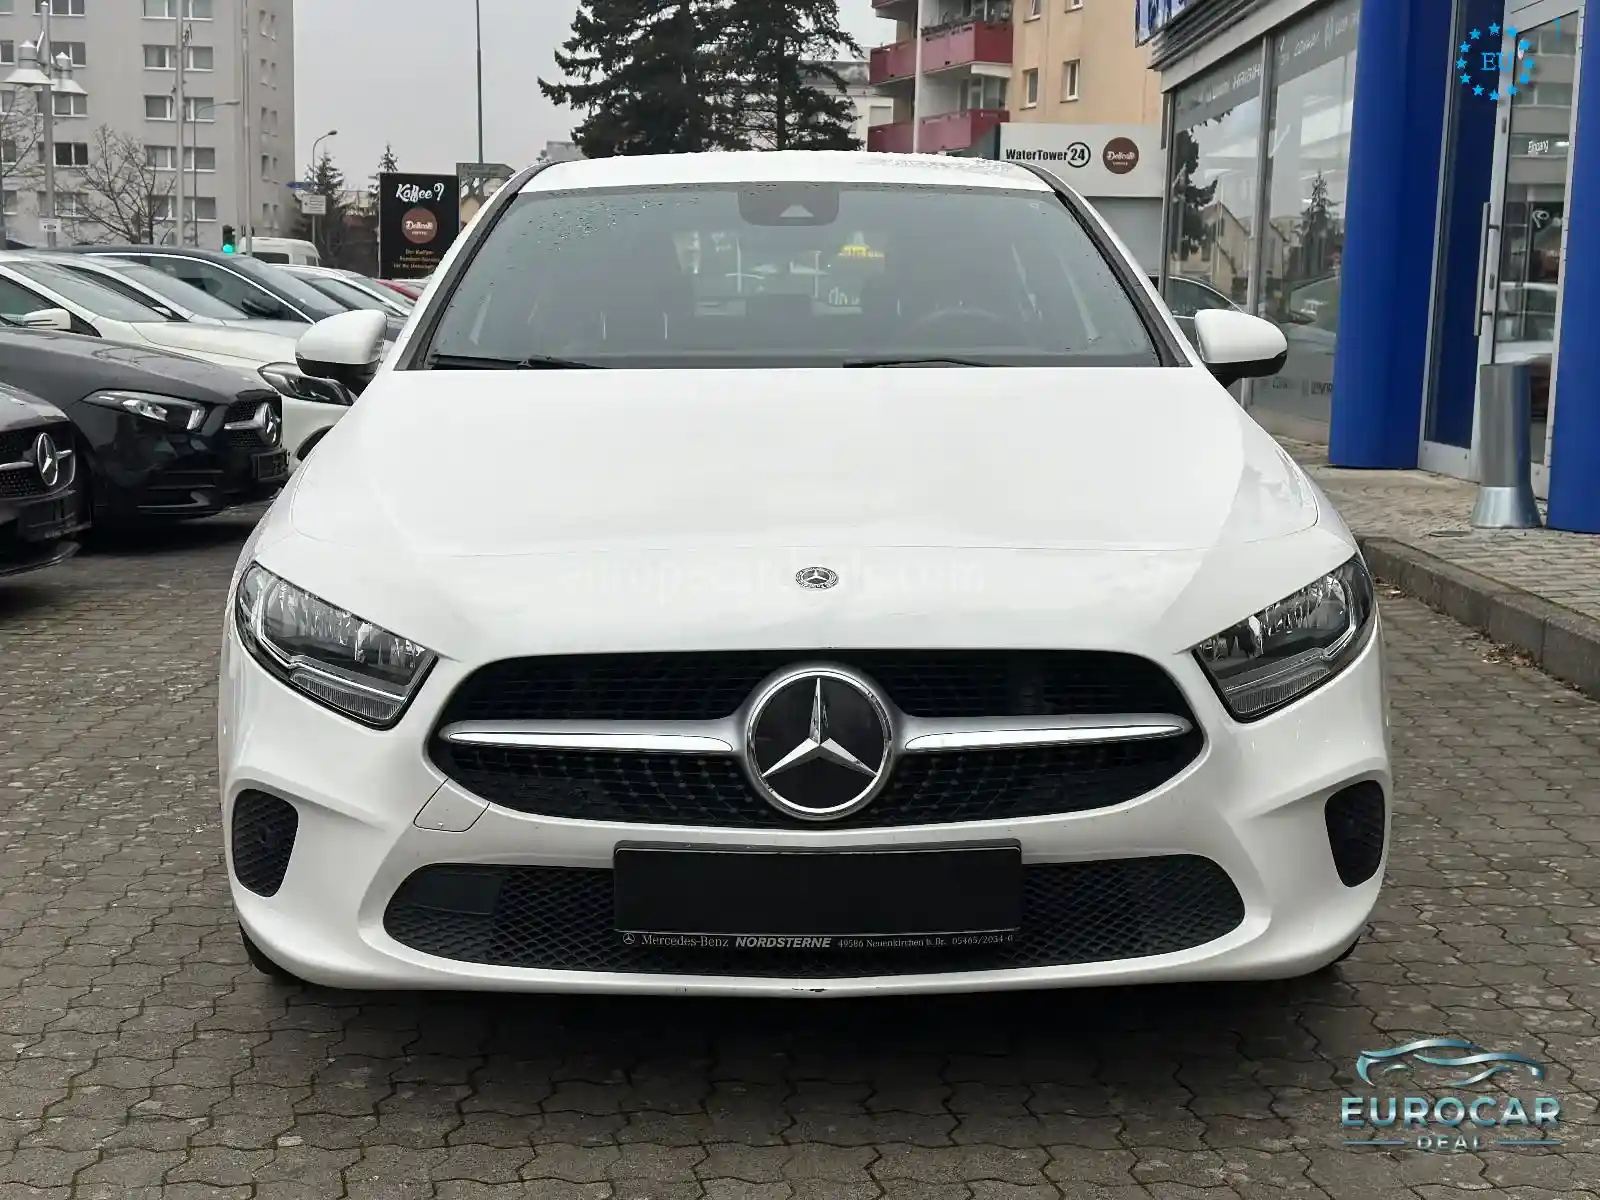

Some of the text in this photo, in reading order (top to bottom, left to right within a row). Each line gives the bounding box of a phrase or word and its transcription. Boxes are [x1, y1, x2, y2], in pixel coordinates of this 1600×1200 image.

[1069, 148, 1086, 161] 24
[641, 934, 729, 947] Mercedes-Benz
[735, 936, 832, 948] NORDSTERNE
